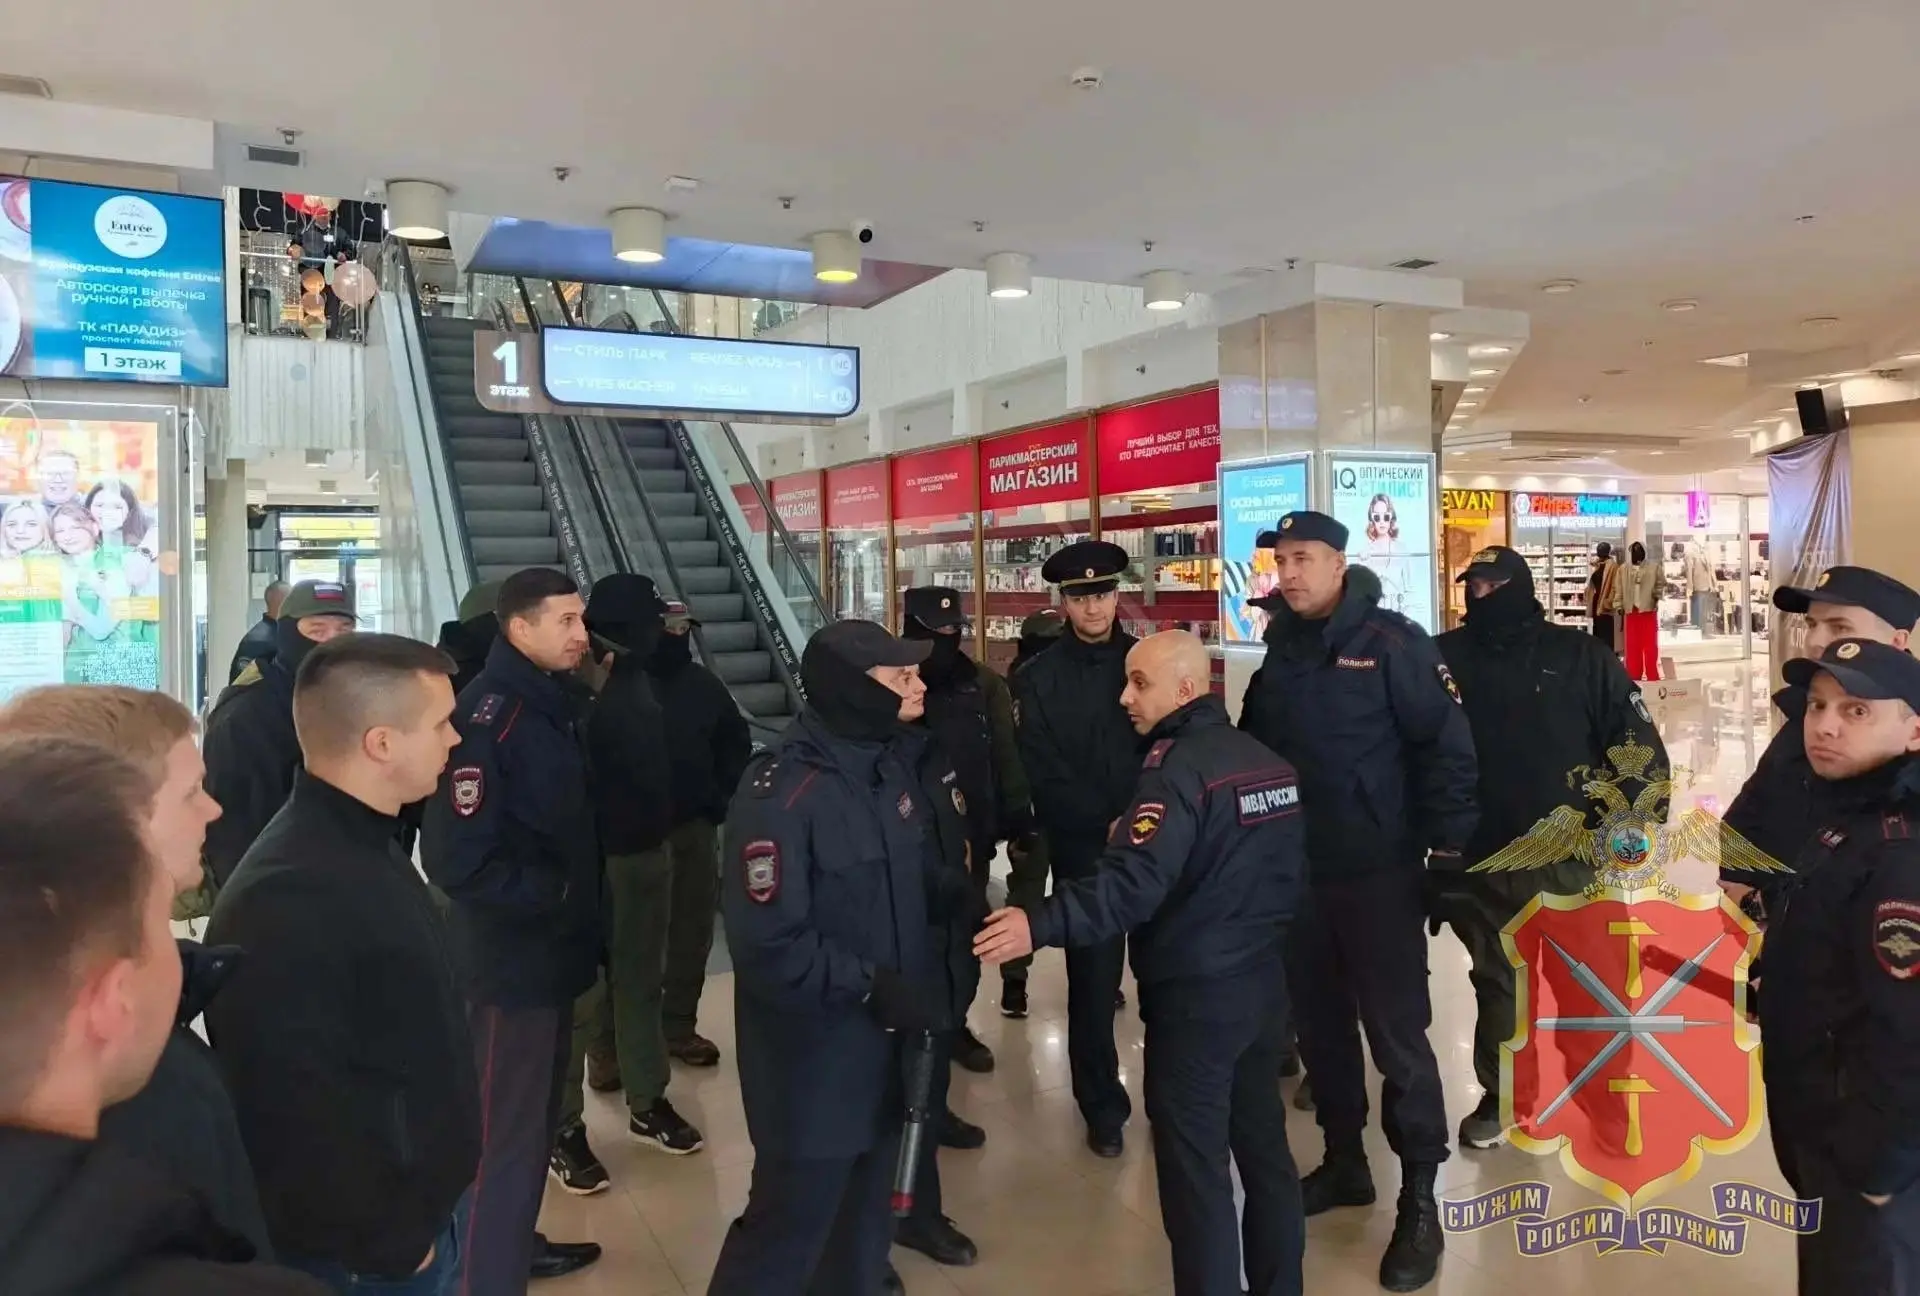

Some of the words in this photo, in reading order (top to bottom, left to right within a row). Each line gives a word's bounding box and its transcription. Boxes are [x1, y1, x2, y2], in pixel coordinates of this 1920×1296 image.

[126, 267, 181, 280] кофейня
[56, 278, 138, 295] Авторская
[142, 288, 206, 301] выпечка
[71, 292, 129, 306] ручной
[133, 297, 187, 311] работы
[78, 321, 96, 333] ТК
[101, 323, 187, 338] «ПАРАДИЗ»
[81, 334, 131, 345] проспект
[574, 345, 624, 358] СТИЛЬ
[100, 353, 108, 367] 1
[114, 356, 168, 371] этаж
[493, 341, 517, 383] 1
[489, 385, 530, 398] этаж
[1127, 433, 1154, 449] ЛУЧШИЙ
[1157, 430, 1182, 443] ВЫБОР
[1185, 427, 1200, 440] ДЛЯ
[989, 440, 1078, 470] ПАРИКМАСТЕРСКИЙ
[1119, 450, 1132, 461] КТО
[1134, 441, 1186, 459] ПРЕДПОЧИТАЕТ
[990, 461, 1078, 493] МАГАЗИН
[1334, 467, 1357, 490] IQ
[1360, 466, 1423, 480] ОПТИЧЕСКИЙ
[1360, 480, 1424, 498] СТИЛИСТ
[1240, 791, 1269, 814] МВД
[1265, 785, 1299, 808] РОССИИ
